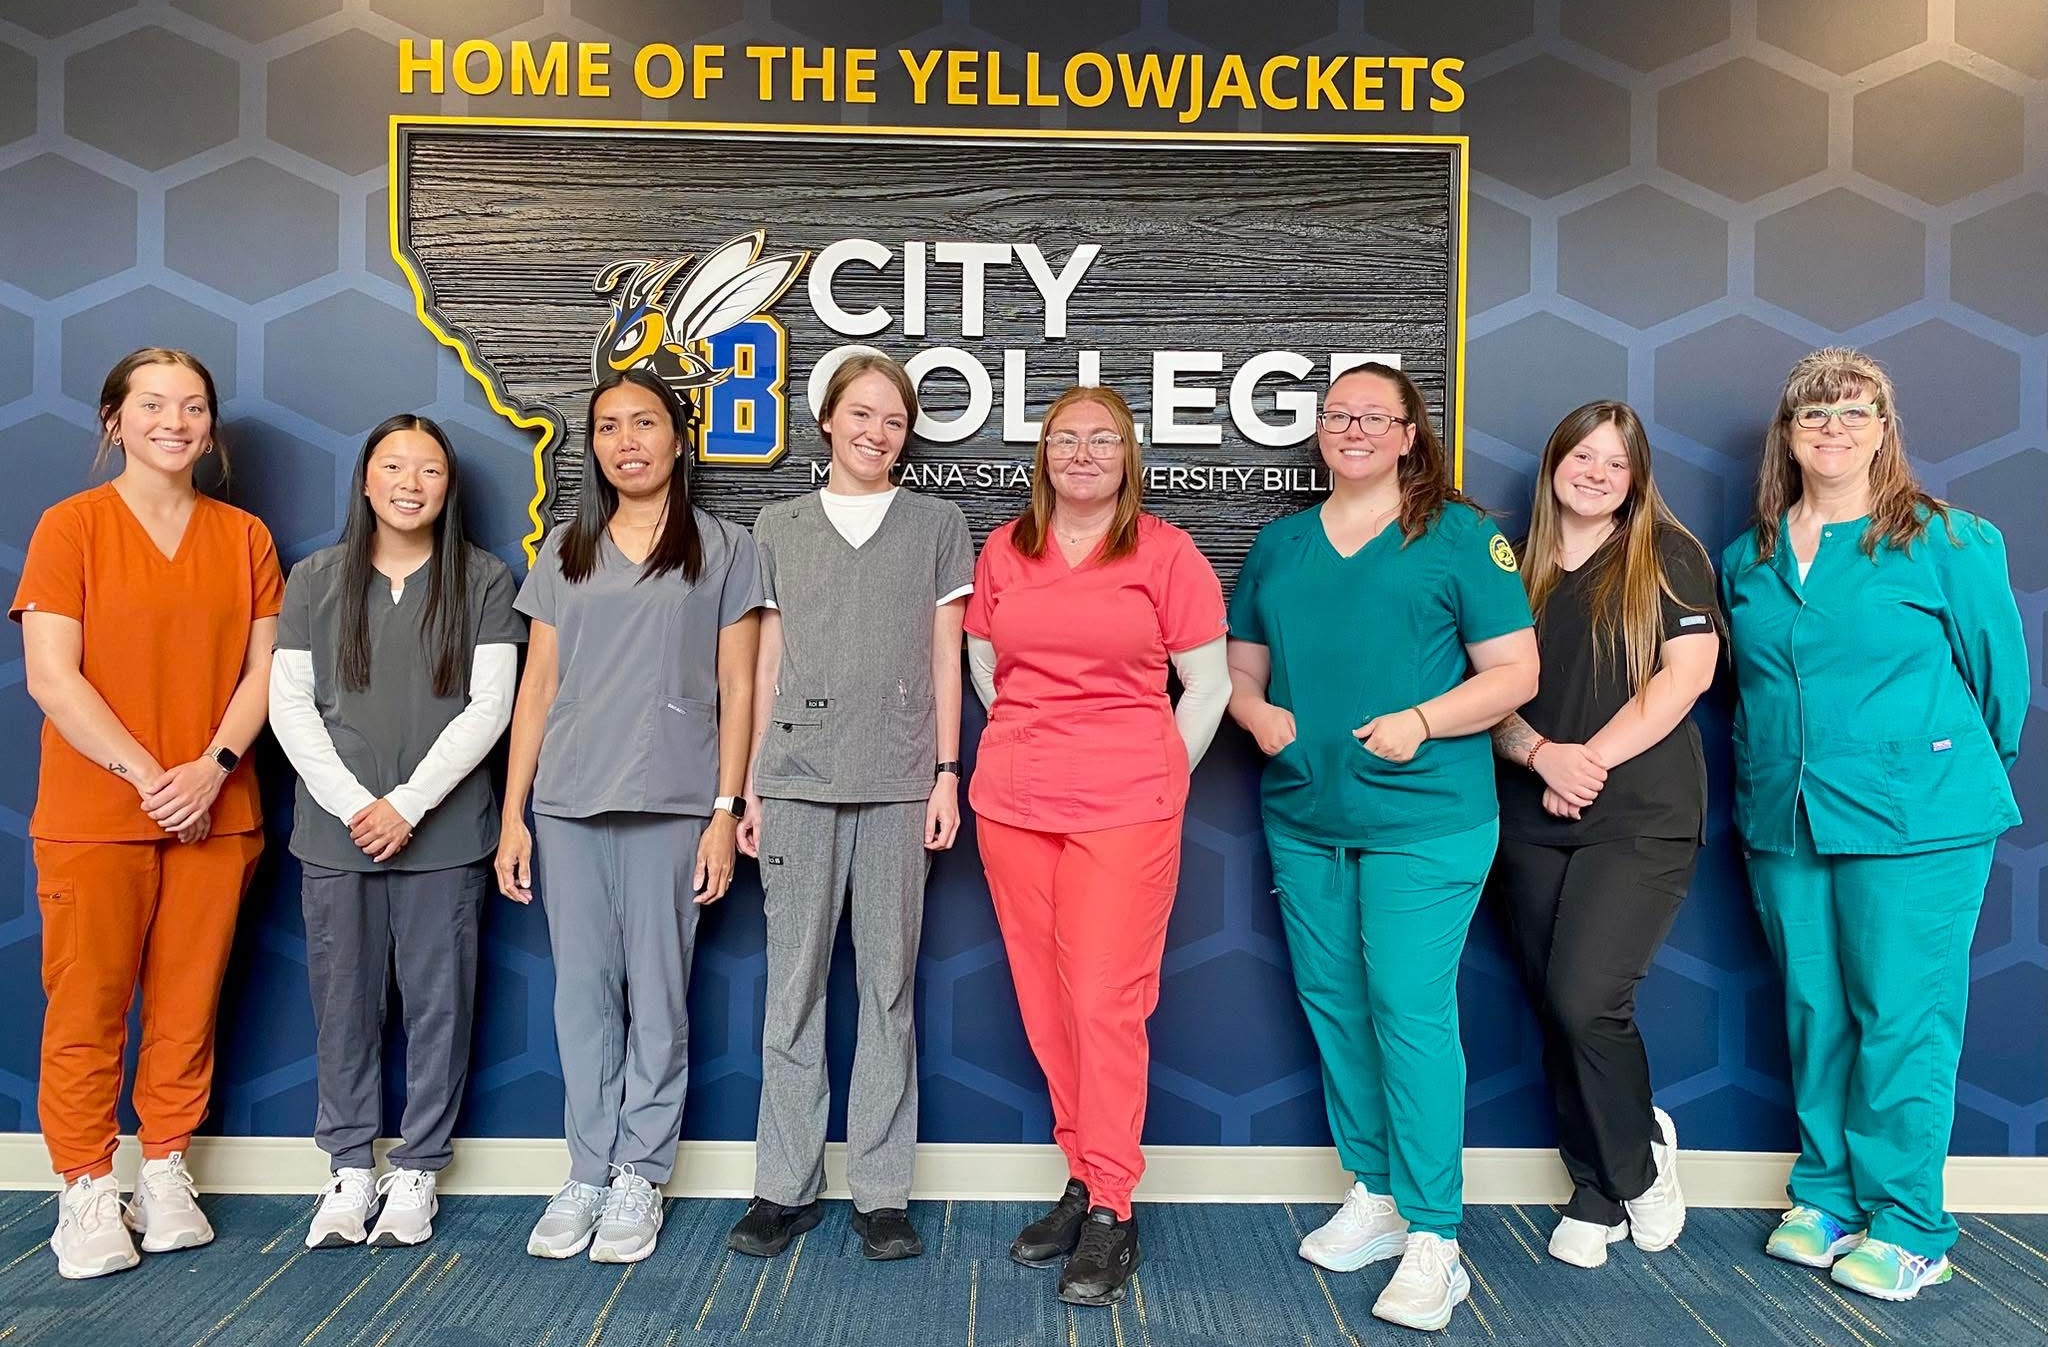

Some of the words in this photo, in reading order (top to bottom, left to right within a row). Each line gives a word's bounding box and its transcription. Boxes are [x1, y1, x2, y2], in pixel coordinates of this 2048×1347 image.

[397, 37, 610, 97] HOME
[633, 42, 725, 99] OF
[746, 46, 876, 103] THE
[900, 49, 1465, 124] YELLOWJACKETS
[808, 238, 1102, 338] CITY
[808, 344, 1402, 447] OLEG
[810, 460, 967, 488] MANA
[975, 463, 1036, 488] STA
[1141, 466, 1257, 491] ERSITY
[1263, 467, 1334, 491] BILLI
